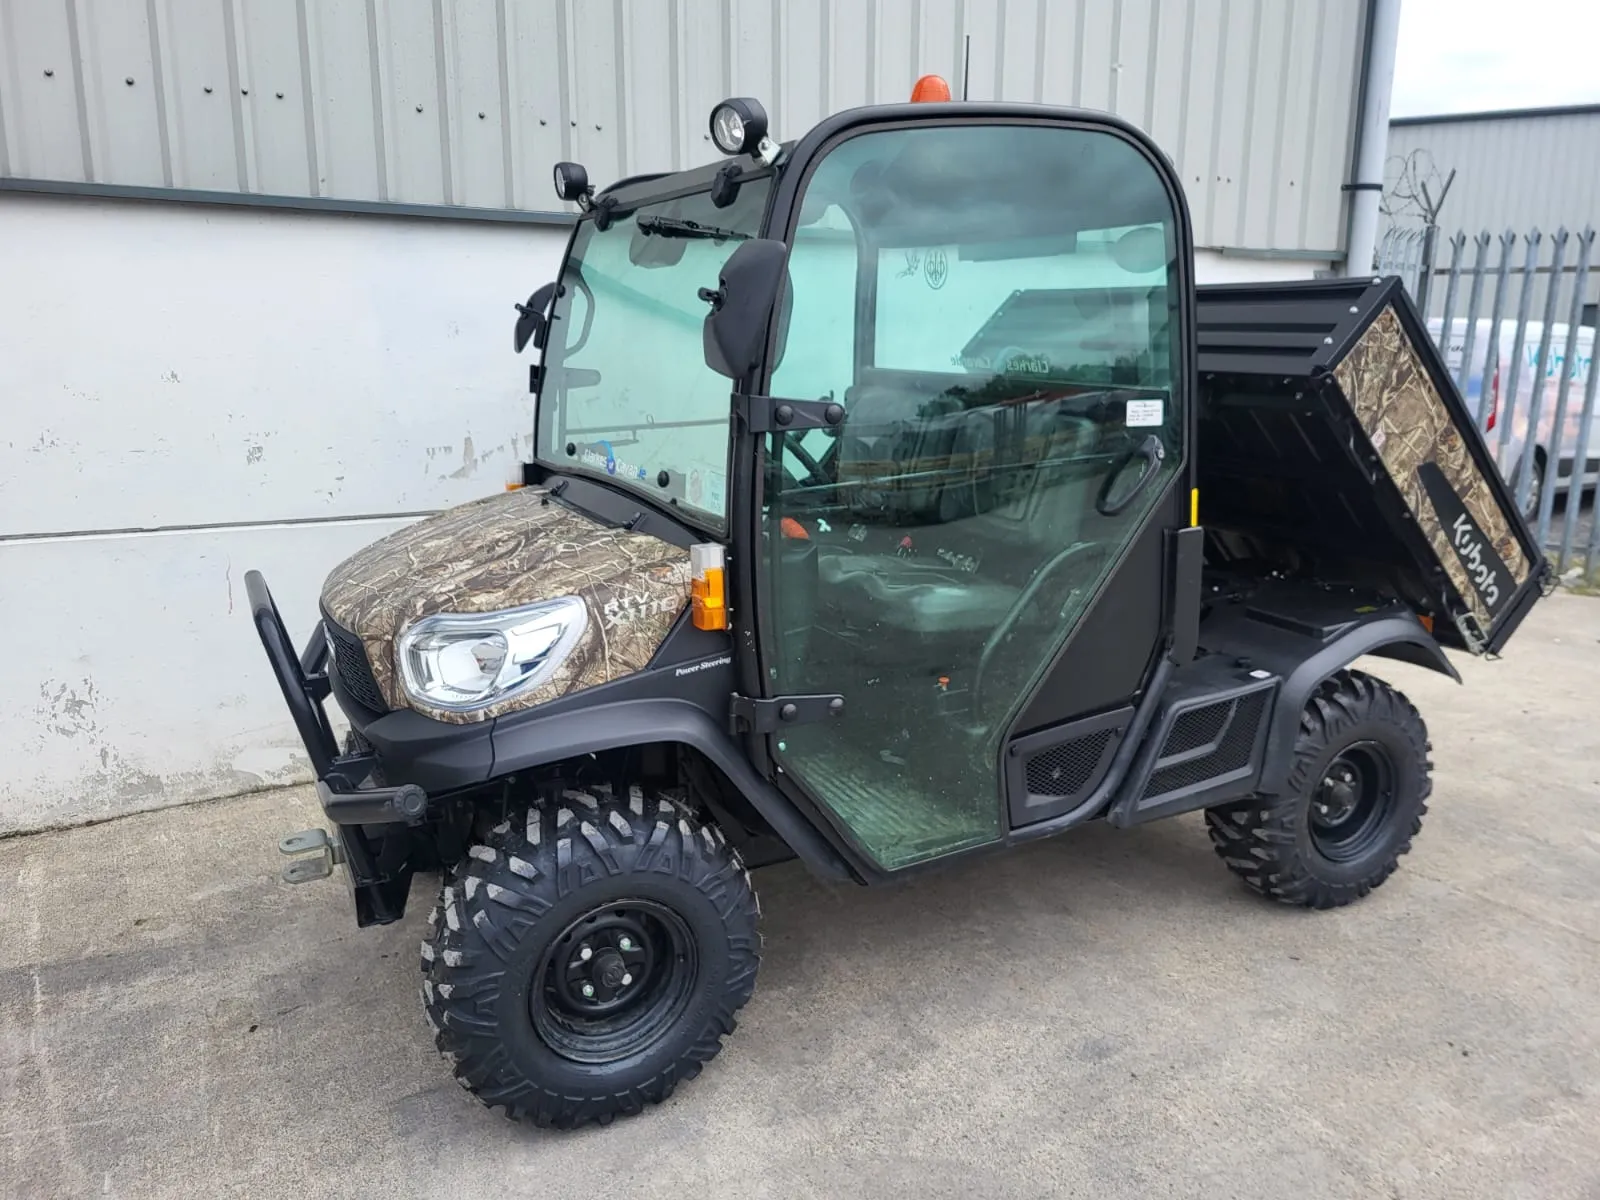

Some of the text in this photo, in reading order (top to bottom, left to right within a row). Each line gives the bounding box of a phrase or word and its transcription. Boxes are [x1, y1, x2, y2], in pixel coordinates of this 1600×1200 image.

[1453, 513, 1499, 607] Kubota
[675, 656, 732, 677] Power Steering
